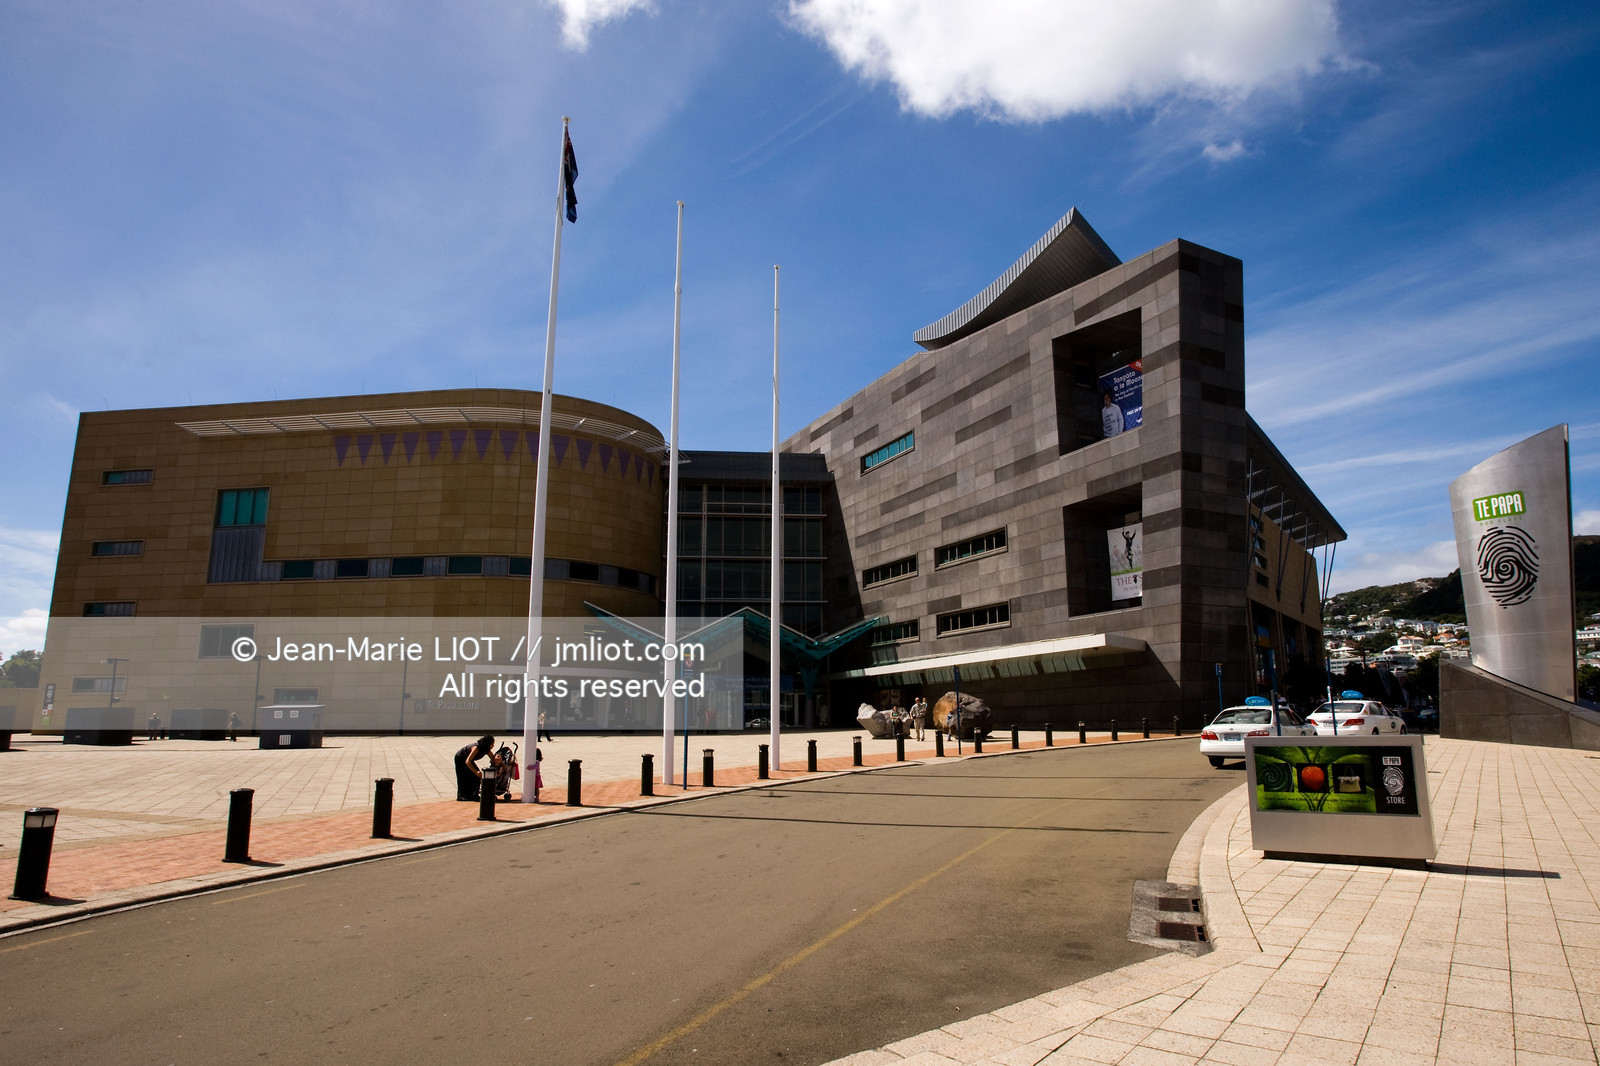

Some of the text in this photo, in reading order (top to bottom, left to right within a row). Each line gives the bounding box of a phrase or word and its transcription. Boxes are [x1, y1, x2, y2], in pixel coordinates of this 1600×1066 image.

[1125, 376, 1142, 387] Moan
[1475, 493, 1523, 519] TE PAPA
[1116, 576, 1133, 586] THE
[1386, 796, 1406, 804] STORE
